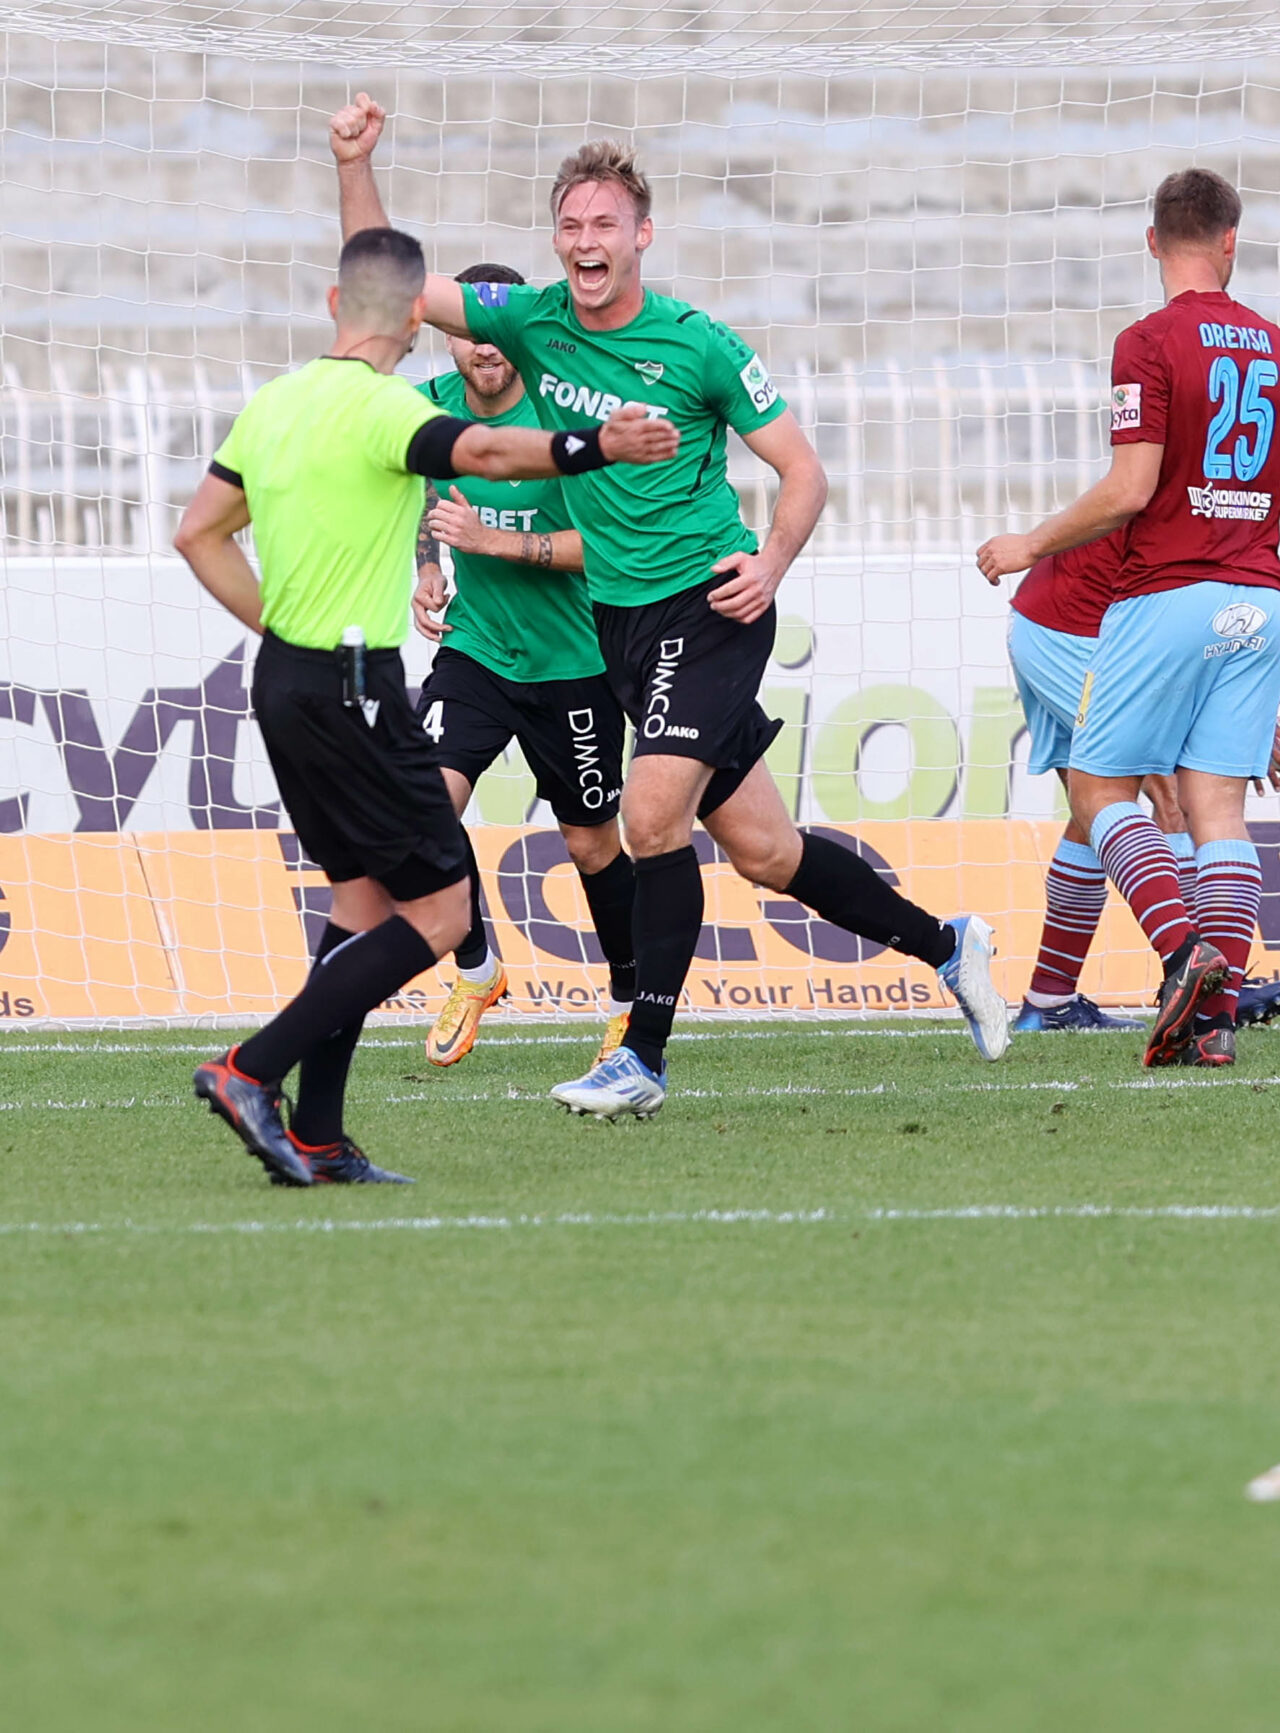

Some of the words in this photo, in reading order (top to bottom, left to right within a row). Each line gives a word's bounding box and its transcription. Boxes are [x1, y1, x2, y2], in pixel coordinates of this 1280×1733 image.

[546, 338, 577, 354] JAKO
[1203, 356, 1279, 482] 25
[472, 505, 539, 532] BET
[644, 637, 684, 739] DIMCO
[664, 725, 700, 740] JAKO
[567, 707, 603, 809] DIMCO
[636, 990, 676, 1006] JAKO
[702, 978, 794, 1005] Your
[806, 977, 931, 1005] Hands
